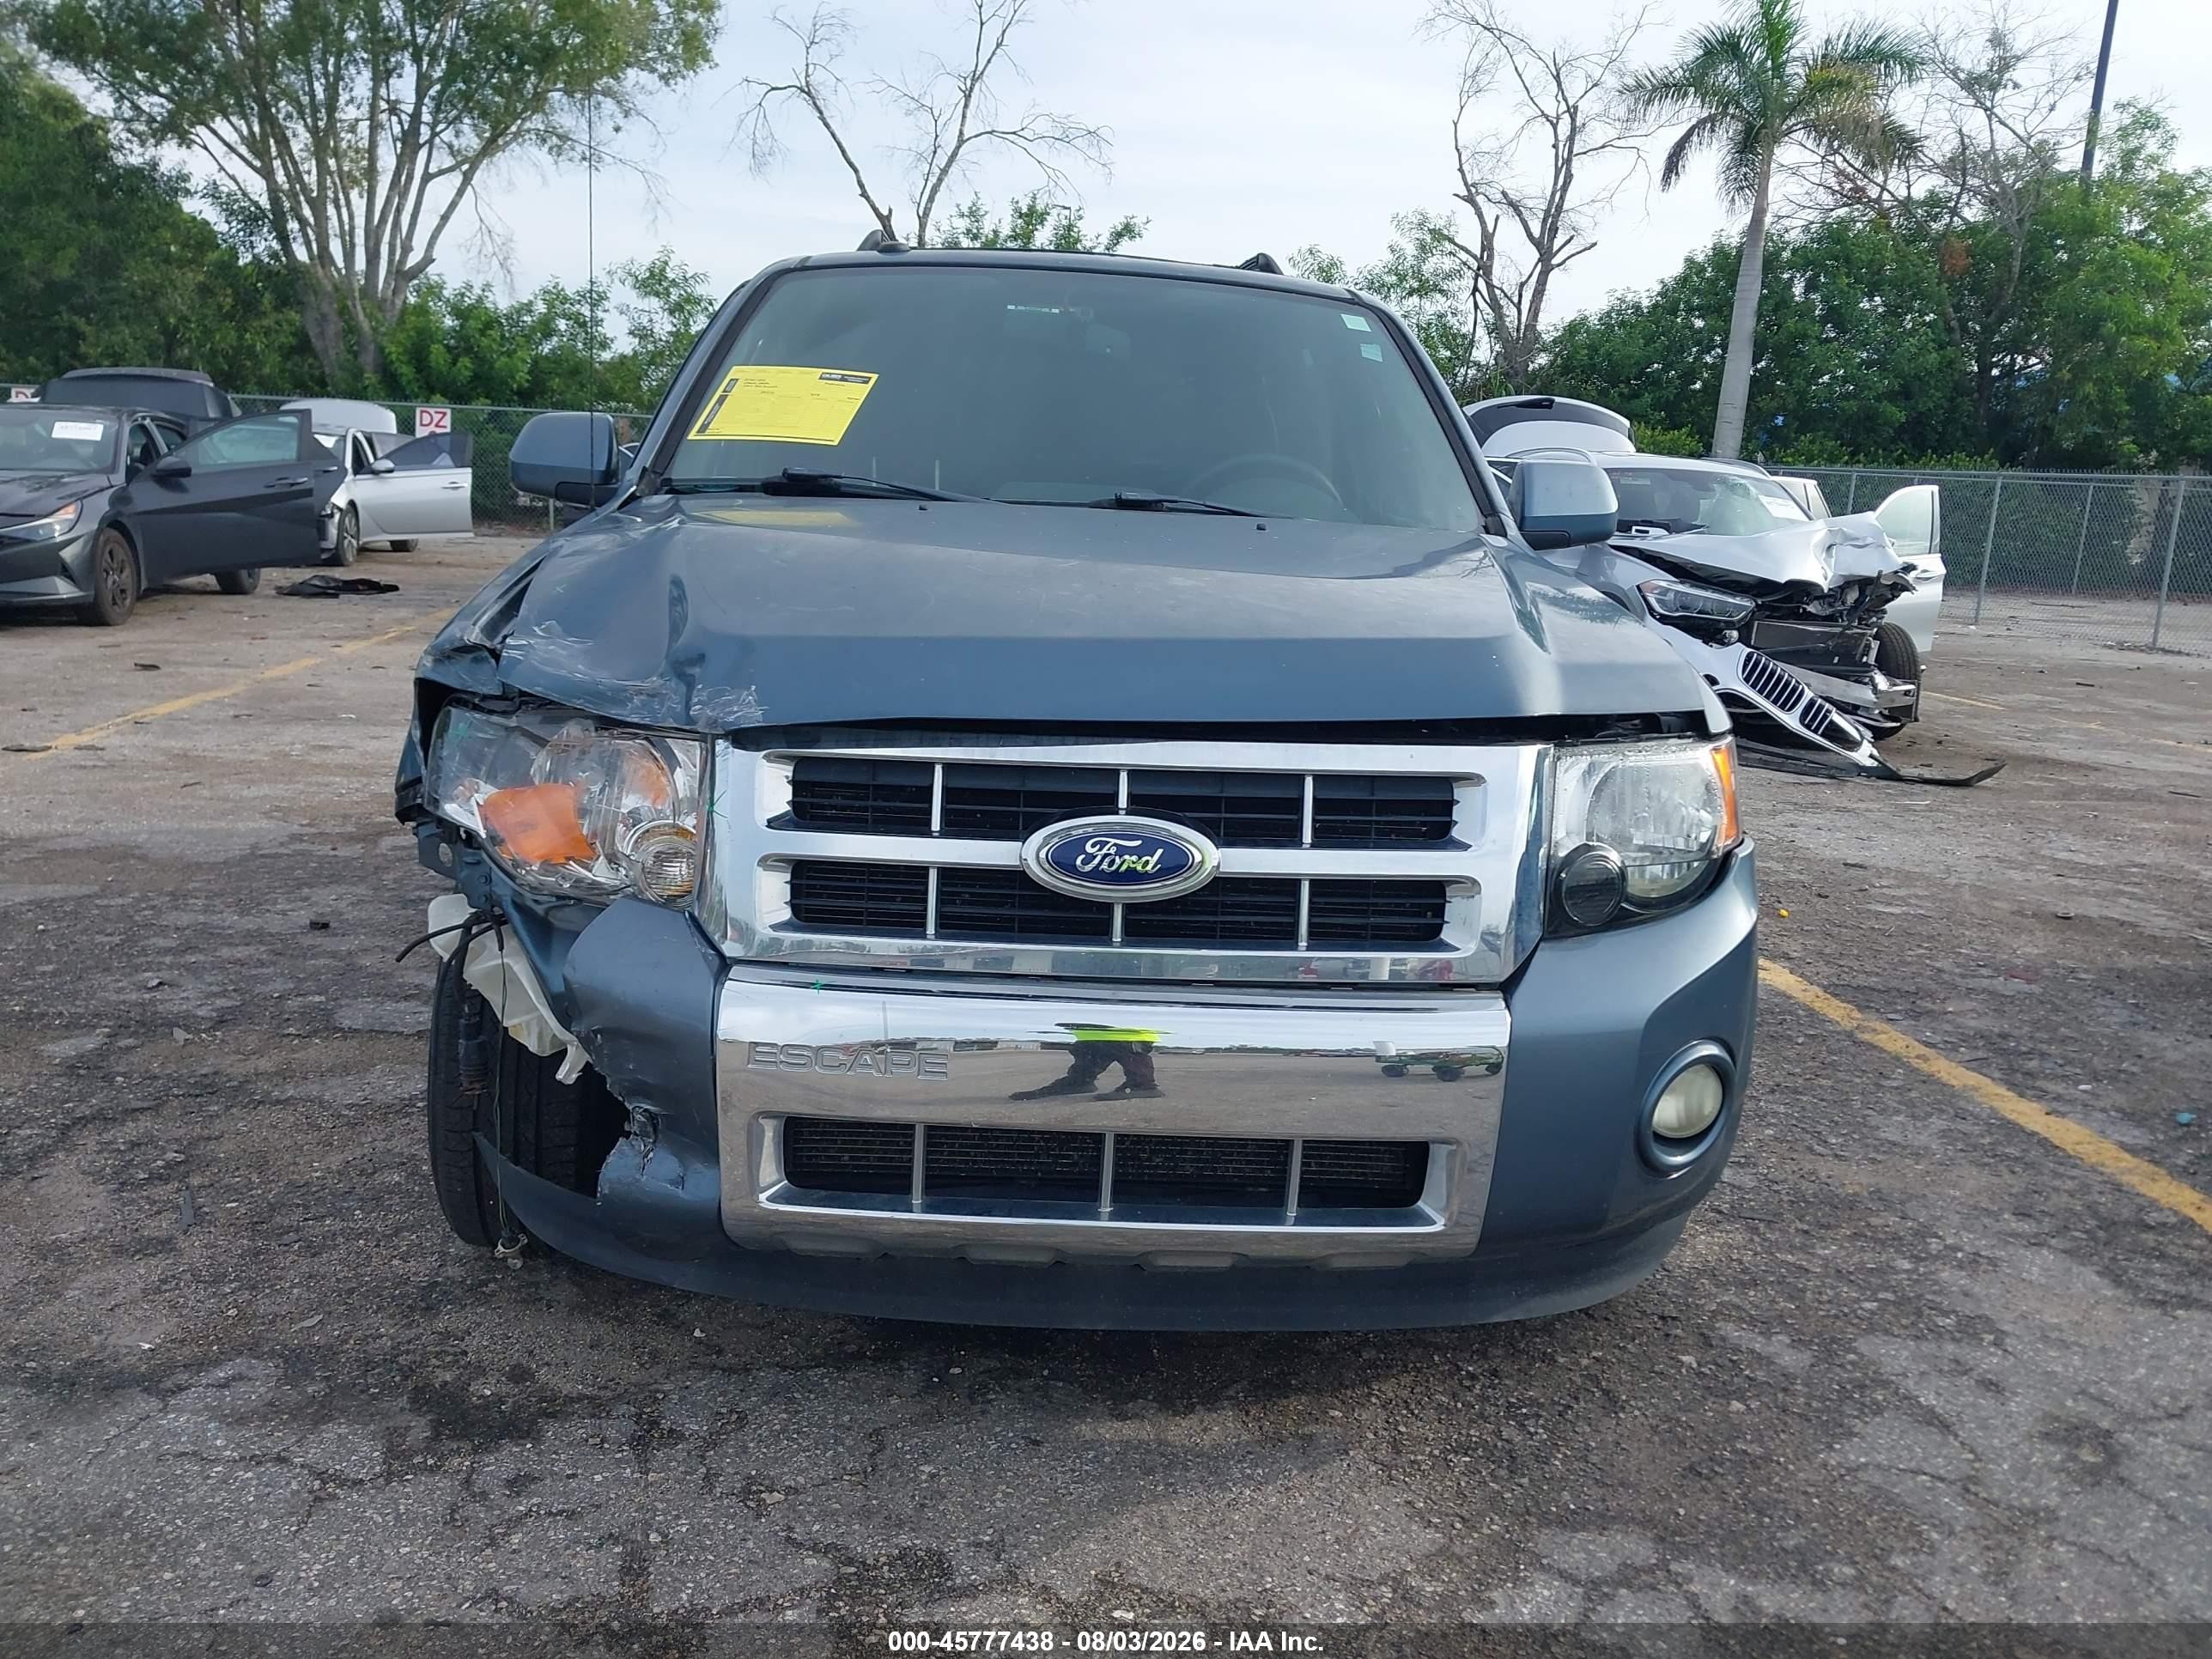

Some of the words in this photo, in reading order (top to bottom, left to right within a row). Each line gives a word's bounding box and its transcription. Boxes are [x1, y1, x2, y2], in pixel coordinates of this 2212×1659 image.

[419, 409, 447, 428] DZ
[1075, 836, 1164, 873] Ford
[747, 1041, 949, 1081] ESCAPE
